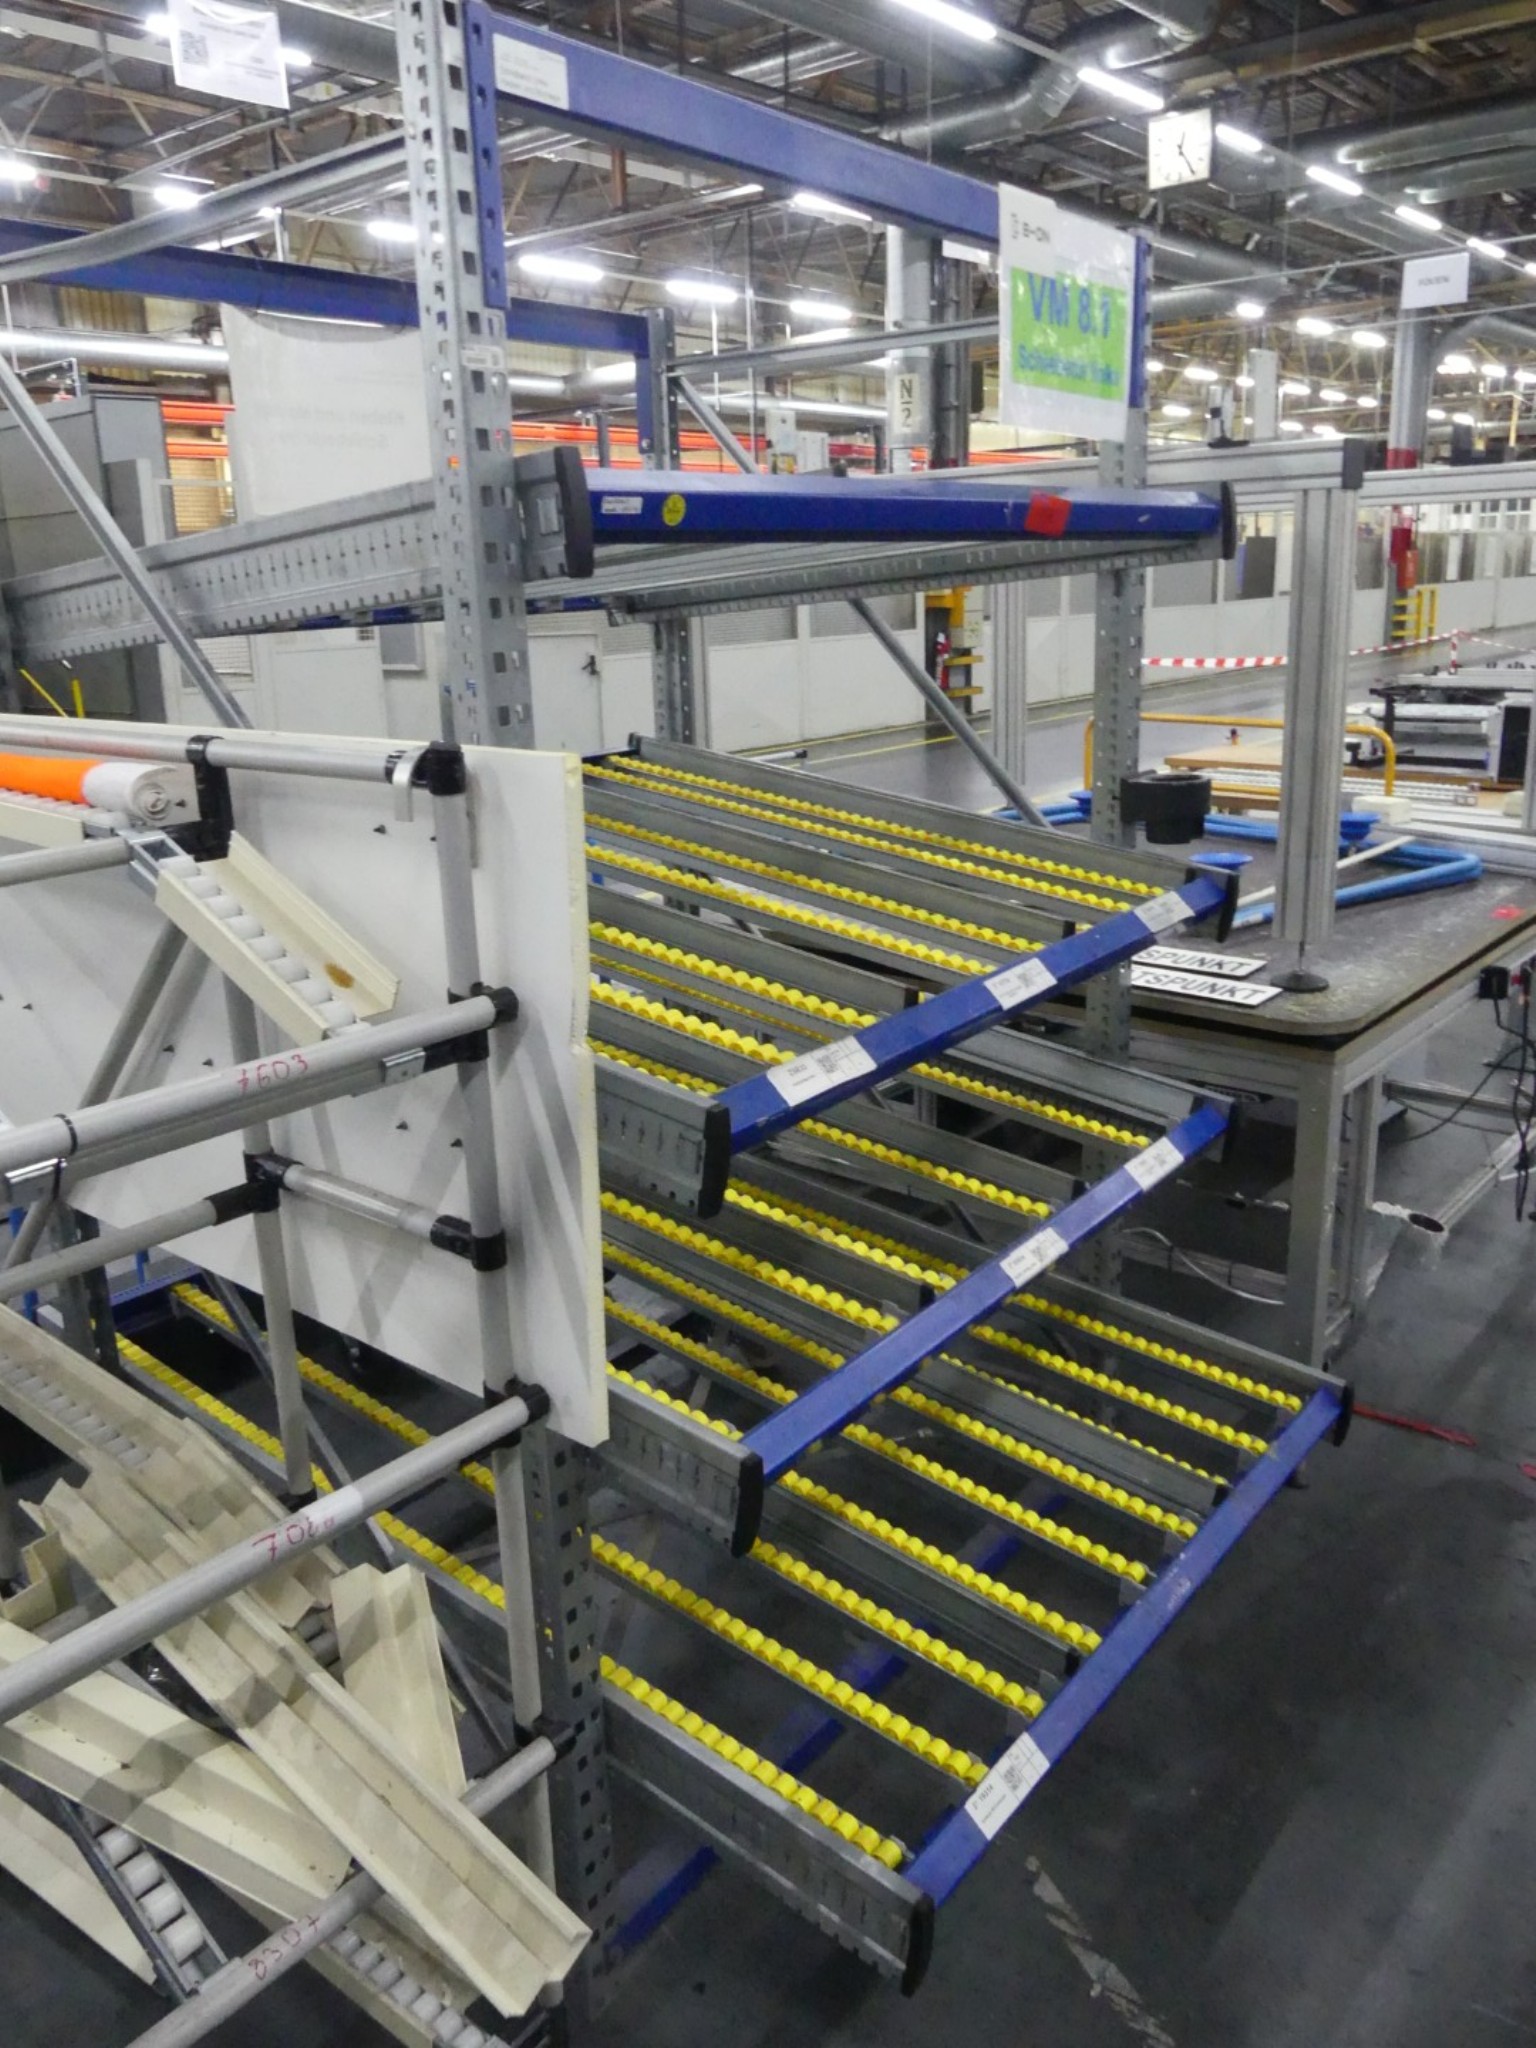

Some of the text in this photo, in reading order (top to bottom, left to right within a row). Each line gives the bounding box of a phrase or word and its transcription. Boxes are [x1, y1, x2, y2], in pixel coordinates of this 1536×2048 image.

[1027, 272, 1070, 327] VM
[899, 378, 913, 399] N
[901, 407, 912, 428] 2
